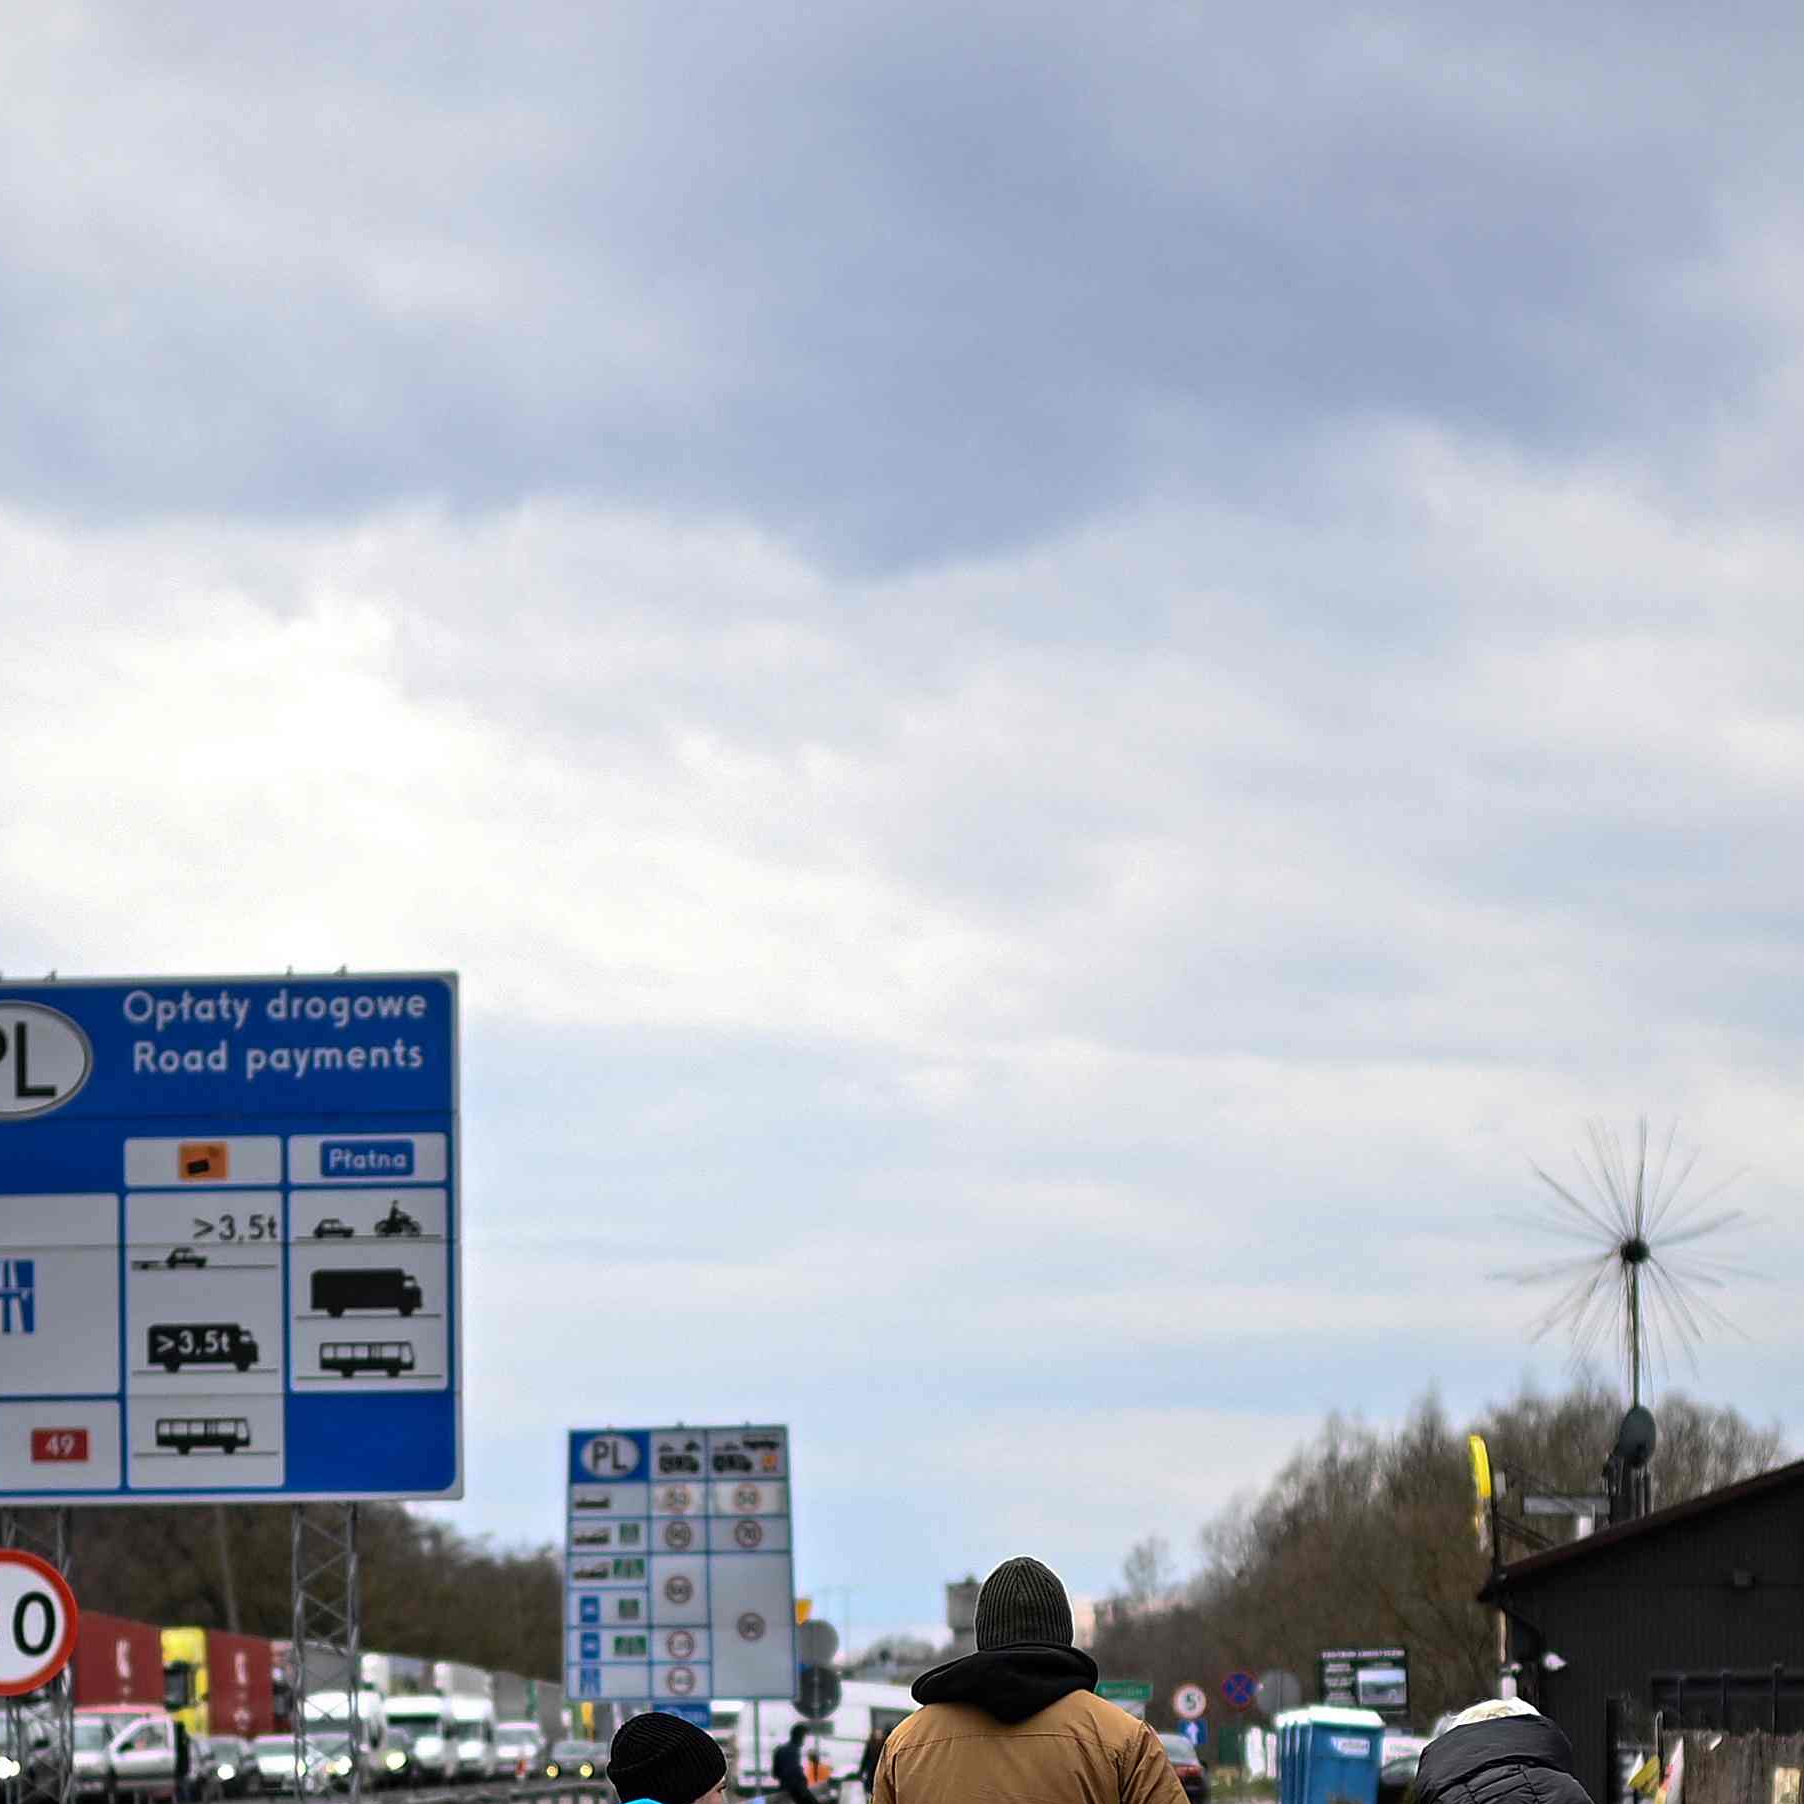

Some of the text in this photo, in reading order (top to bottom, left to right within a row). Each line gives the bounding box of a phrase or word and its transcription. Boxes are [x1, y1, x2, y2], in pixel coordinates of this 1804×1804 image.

[123, 988, 427, 1031] Opłaty drogowe
[133, 1037, 423, 1079] Road payments
[329, 1148, 407, 1169] Płatna
[45, 1435, 75, 1456] 49
[592, 1440, 628, 1471] PL
